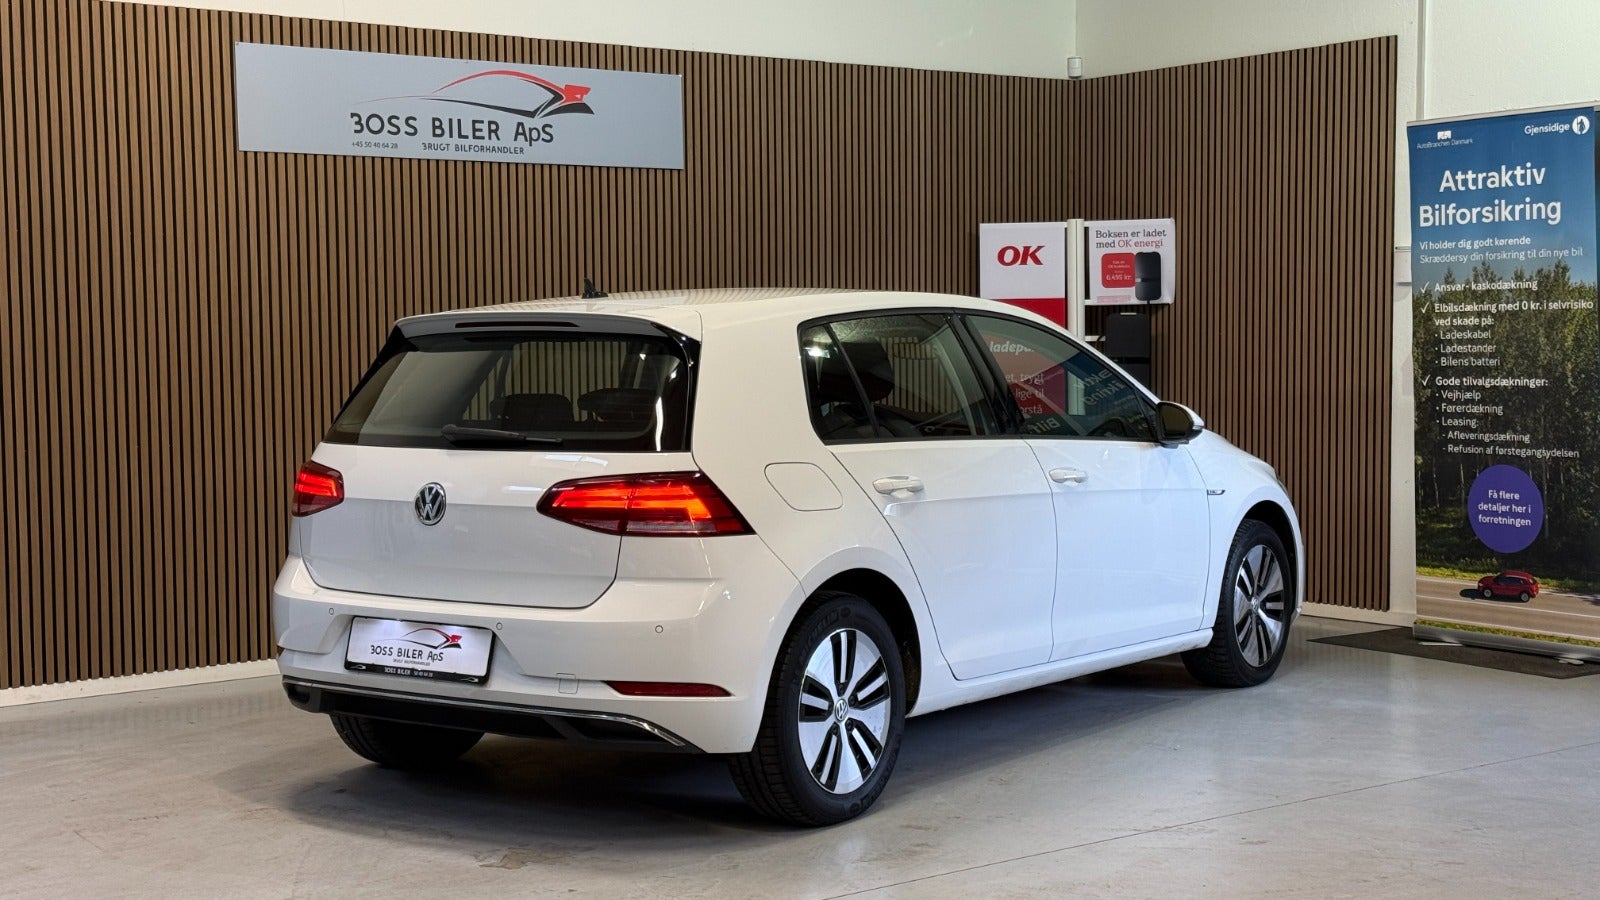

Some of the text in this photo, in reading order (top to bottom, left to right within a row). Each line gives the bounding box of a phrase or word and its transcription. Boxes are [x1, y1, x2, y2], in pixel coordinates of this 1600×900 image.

[431, 117, 500, 141] BILER
[514, 121, 554, 147] ApS
[1524, 122, 1570, 136] Gjensidige
[352, 140, 363, 148] +45
[1451, 138, 1473, 146] Danmark
[454, 144, 525, 155] BILFORHANDLER
[1439, 162, 1546, 192] Attraktiv
[1419, 197, 1561, 228] Bilforsikring
[1095, 228, 1167, 238] Boksen er ladet
[1096, 239, 1163, 249] med OK energi
[1420, 236, 1531, 250] Vi holder dig godt kørende
[997, 246, 1046, 267] OK
[1420, 247, 1583, 264] Skræddersy din forsikring til din nye bil
[1434, 280, 1538, 292] Ansvar- kaskodækning
[1434, 302, 1497, 314] Elbilsdækning
[1498, 301, 1519, 311] med
[1522, 301, 1528, 310] 0
[1530, 300, 1542, 310] kr.
[1548, 300, 1594, 310] selvrisiko
[1435, 315, 1494, 328] ved skade på:
[1440, 330, 1491, 340] Ladeskabel
[1440, 344, 1496, 353] Ladestander
[1440, 356, 1500, 366] Bilens batteri
[1436, 376, 1548, 389] Gode tilvalgsdækninger:
[1016, 388, 1032, 400] lige
[1441, 390, 1482, 402] Vejhjælp
[1021, 404, 1042, 414] orstå
[1442, 403, 1504, 416] Førerdækning
[1442, 417, 1479, 428] Leasing:
[1448, 431, 1530, 444] Afleveringsdækning
[1448, 444, 1580, 459] Refusion af førstegangsydelsen
[1488, 489, 1520, 500] Få flere
[1478, 502, 1510, 514] detaljer
[1512, 504, 1526, 513] her
[1478, 514, 1532, 528] forretningen
[397, 648, 423, 660] BILER
[427, 650, 444, 662] ApS
